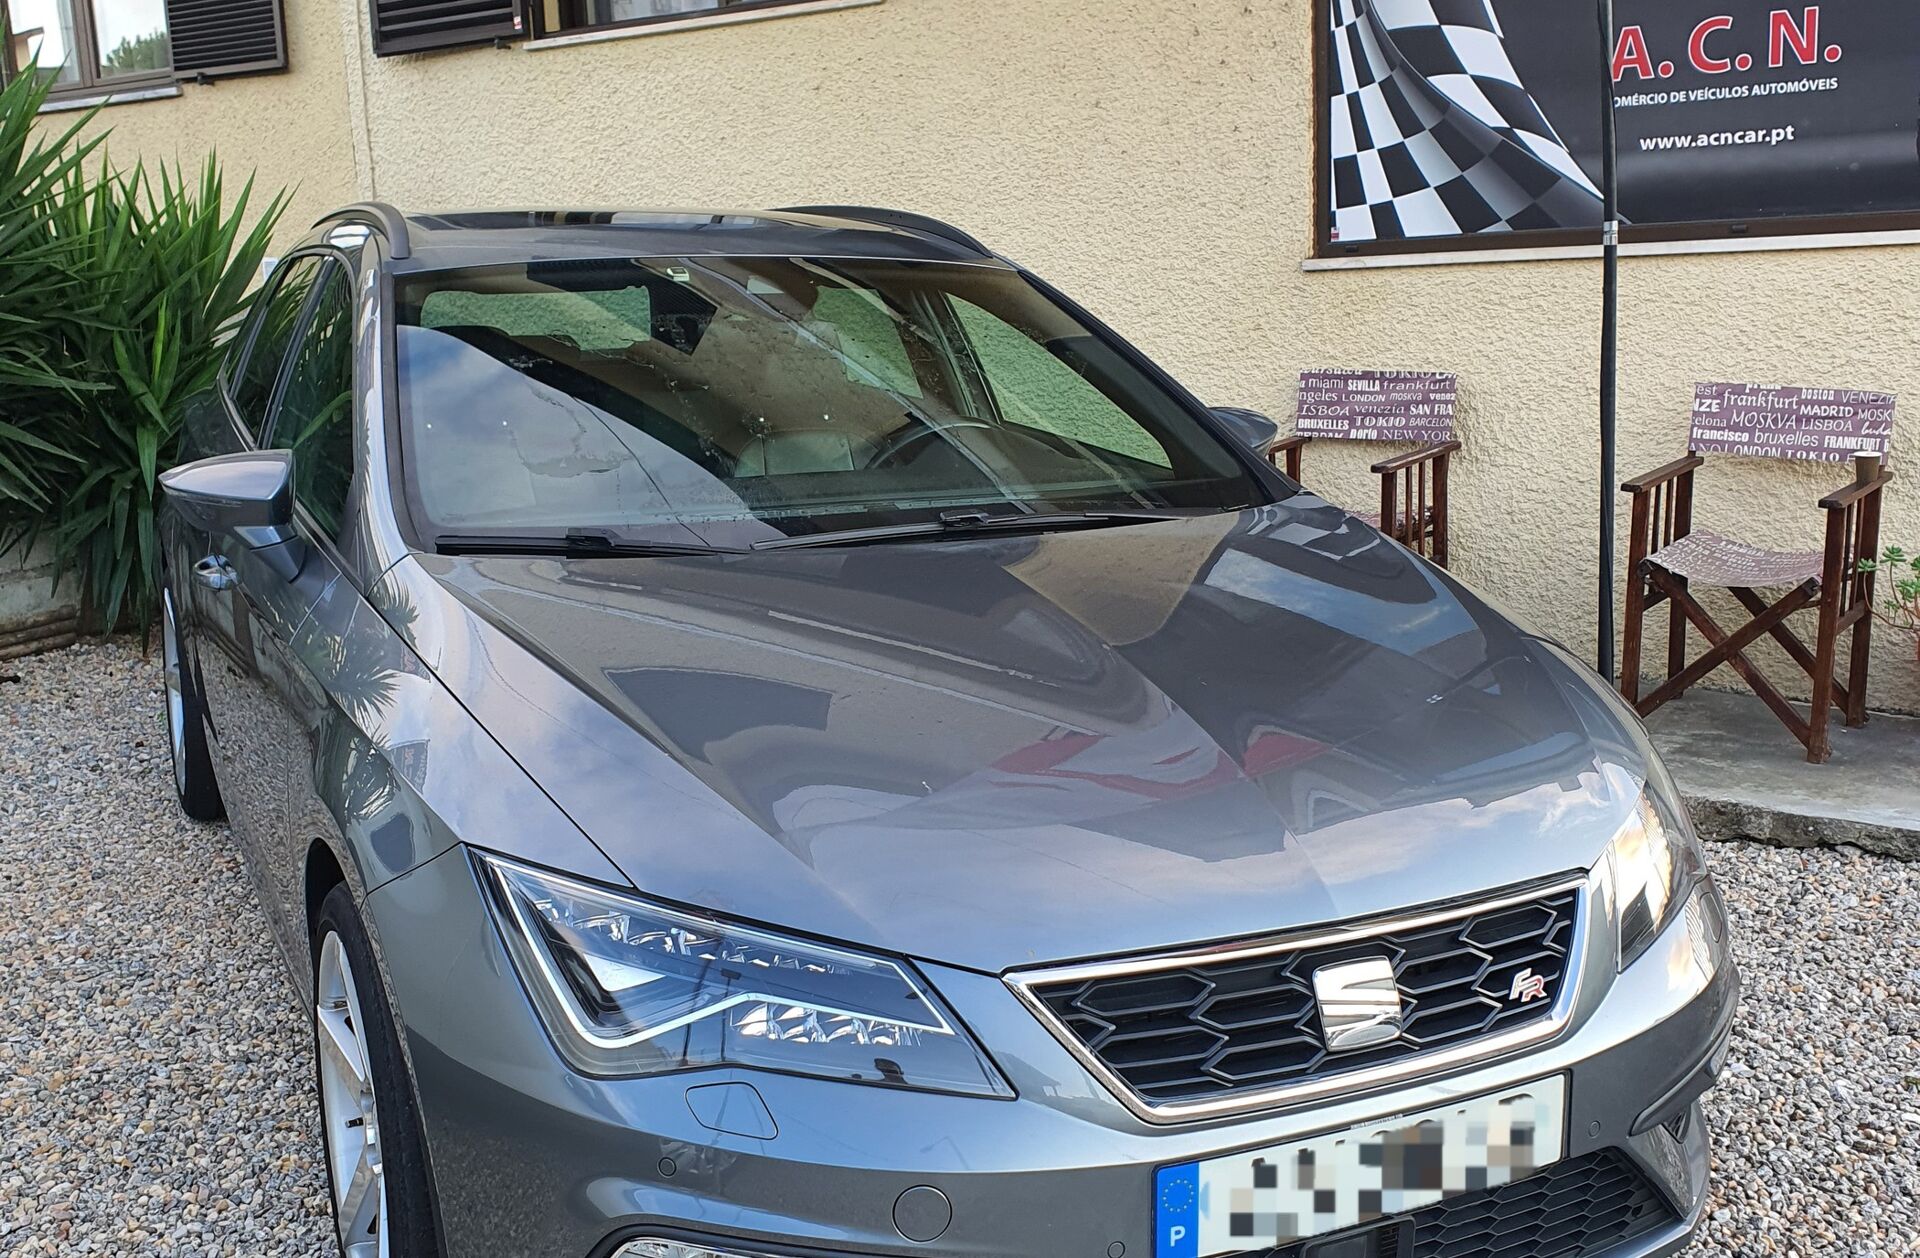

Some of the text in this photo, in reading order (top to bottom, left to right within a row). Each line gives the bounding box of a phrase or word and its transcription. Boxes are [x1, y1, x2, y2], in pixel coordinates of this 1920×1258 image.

[1669, 90, 1687, 103] DE
[1688, 85, 1749, 101] VEÍCULOS
[1751, 77, 1838, 97] AUTOMÓVEIS
[1639, 124, 1795, 151] www.acncar.pt
[1308, 376, 1344, 389] miami
[1347, 379, 1380, 391] SEVILLA
[1383, 380, 1451, 390] frankfurt
[1299, 389, 1338, 403] ngeles
[1342, 393, 1385, 402] LONDON
[1390, 392, 1422, 401] moskva
[1801, 387, 1835, 401] boston
[1301, 404, 1453, 416] ISBOA venezia SAN FRA
[1723, 389, 1799, 412] frankfurt
[1800, 404, 1854, 418] MADRID
[1297, 418, 1350, 430] BRUXELLES
[1354, 416, 1406, 427] TOKIO
[1730, 409, 1797, 430] MOSKVA
[1801, 418, 1853, 432] LISBOA
[1382, 429, 1418, 440] NEW
[1421, 430, 1450, 441] YOR
[1692, 427, 1750, 443] francisco
[1754, 429, 1819, 447] bruxelles
[1824, 435, 1881, 451] FRANKFURT
[1170, 1225, 1186, 1247] P
